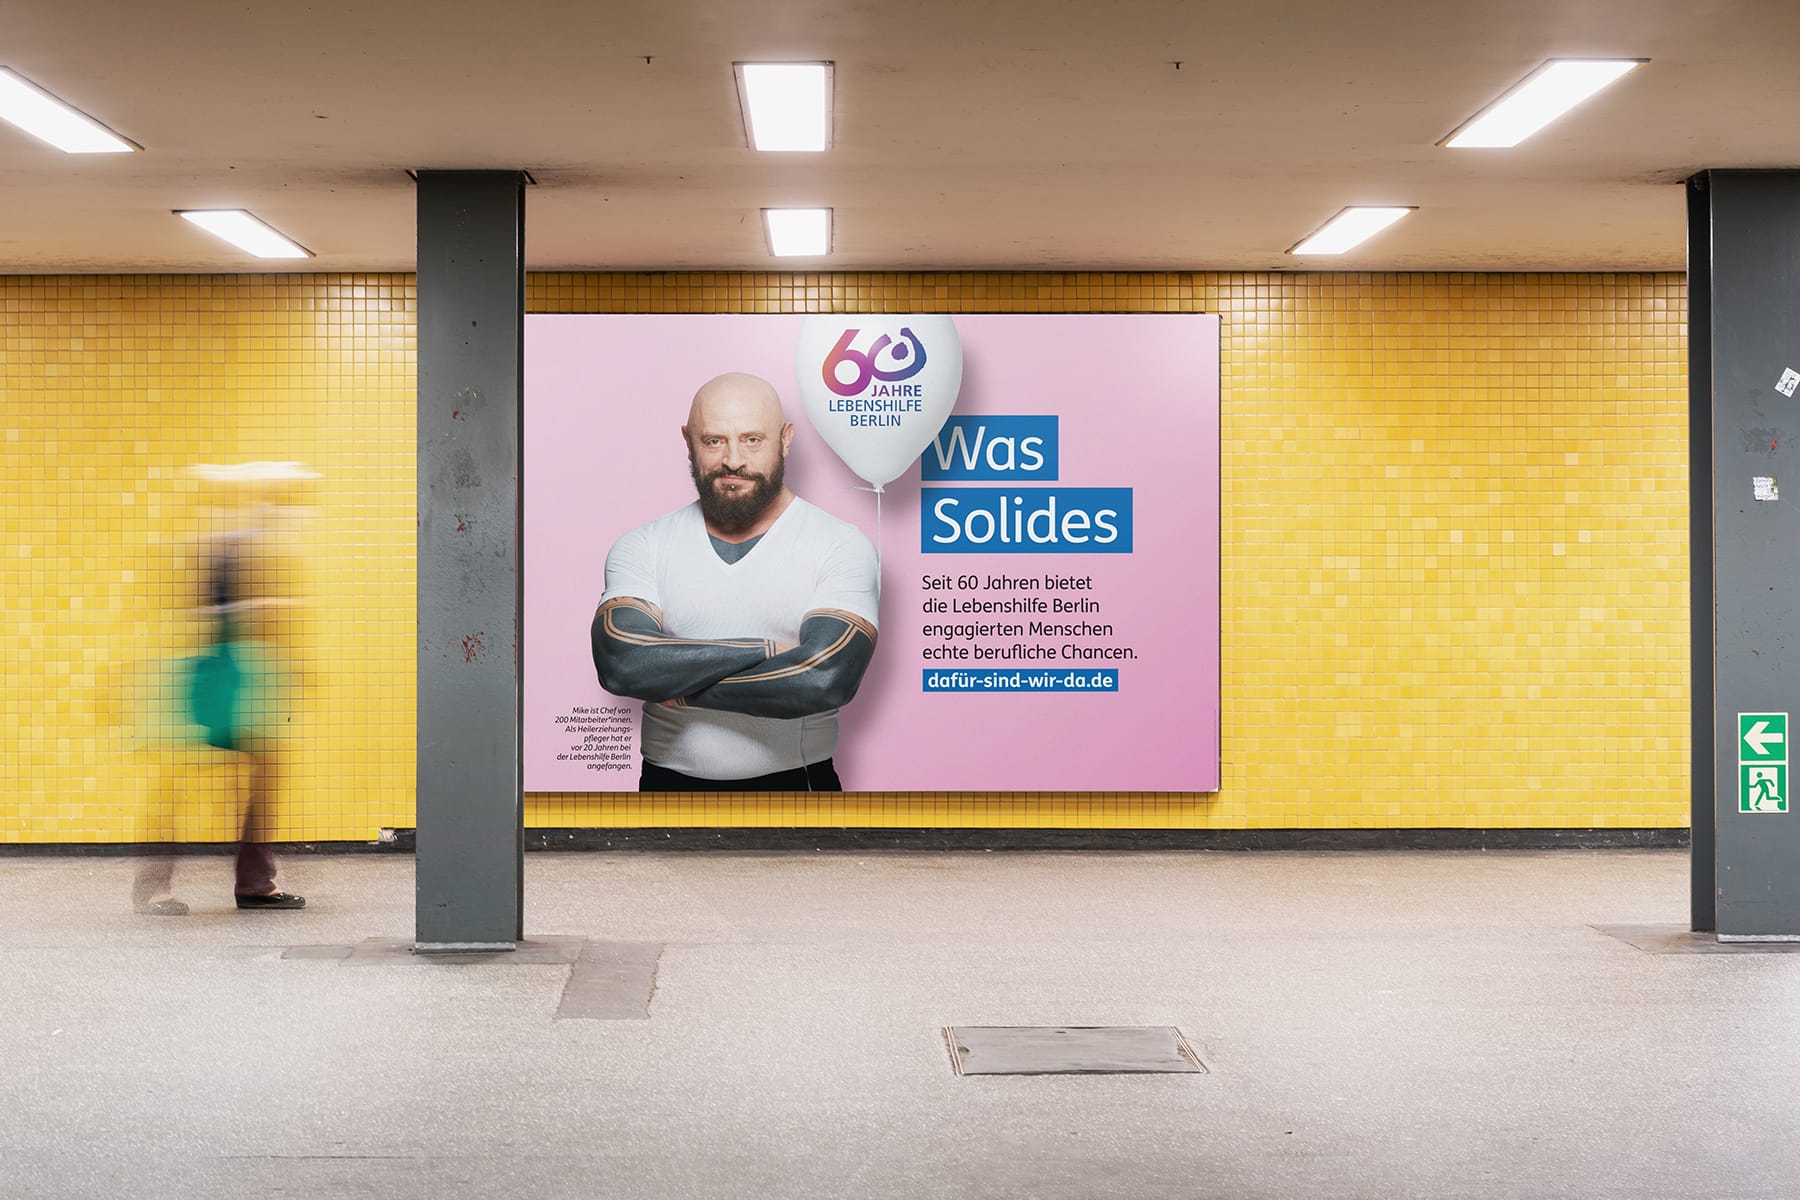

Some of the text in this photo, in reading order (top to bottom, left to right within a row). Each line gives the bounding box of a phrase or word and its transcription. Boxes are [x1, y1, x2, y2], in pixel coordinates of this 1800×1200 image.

[871, 385, 922, 397] JAHRE
[829, 400, 922, 412] LEBENSHILFE
[851, 415, 901, 426] BERLIN
[934, 426, 1043, 471] Was
[933, 496, 1118, 543] Solides
[922, 575, 1092, 590] Seit 60 Jahren bietet
[923, 598, 1099, 613] die Lebenshilfe Berlin
[923, 622, 1112, 640] engagierten Menschen
[923, 645, 1137, 659] echte berufliche Chancen.
[928, 673, 1112, 688] dafür-sind-wir-da.de
[600, 707, 618, 716] Chef
[578, 726, 632, 734] Heilerziehungs-
[584, 735, 609, 743] pfleger
[570, 753, 609, 761] Lebenshilfe
[587, 762, 632, 771] angefangen.
